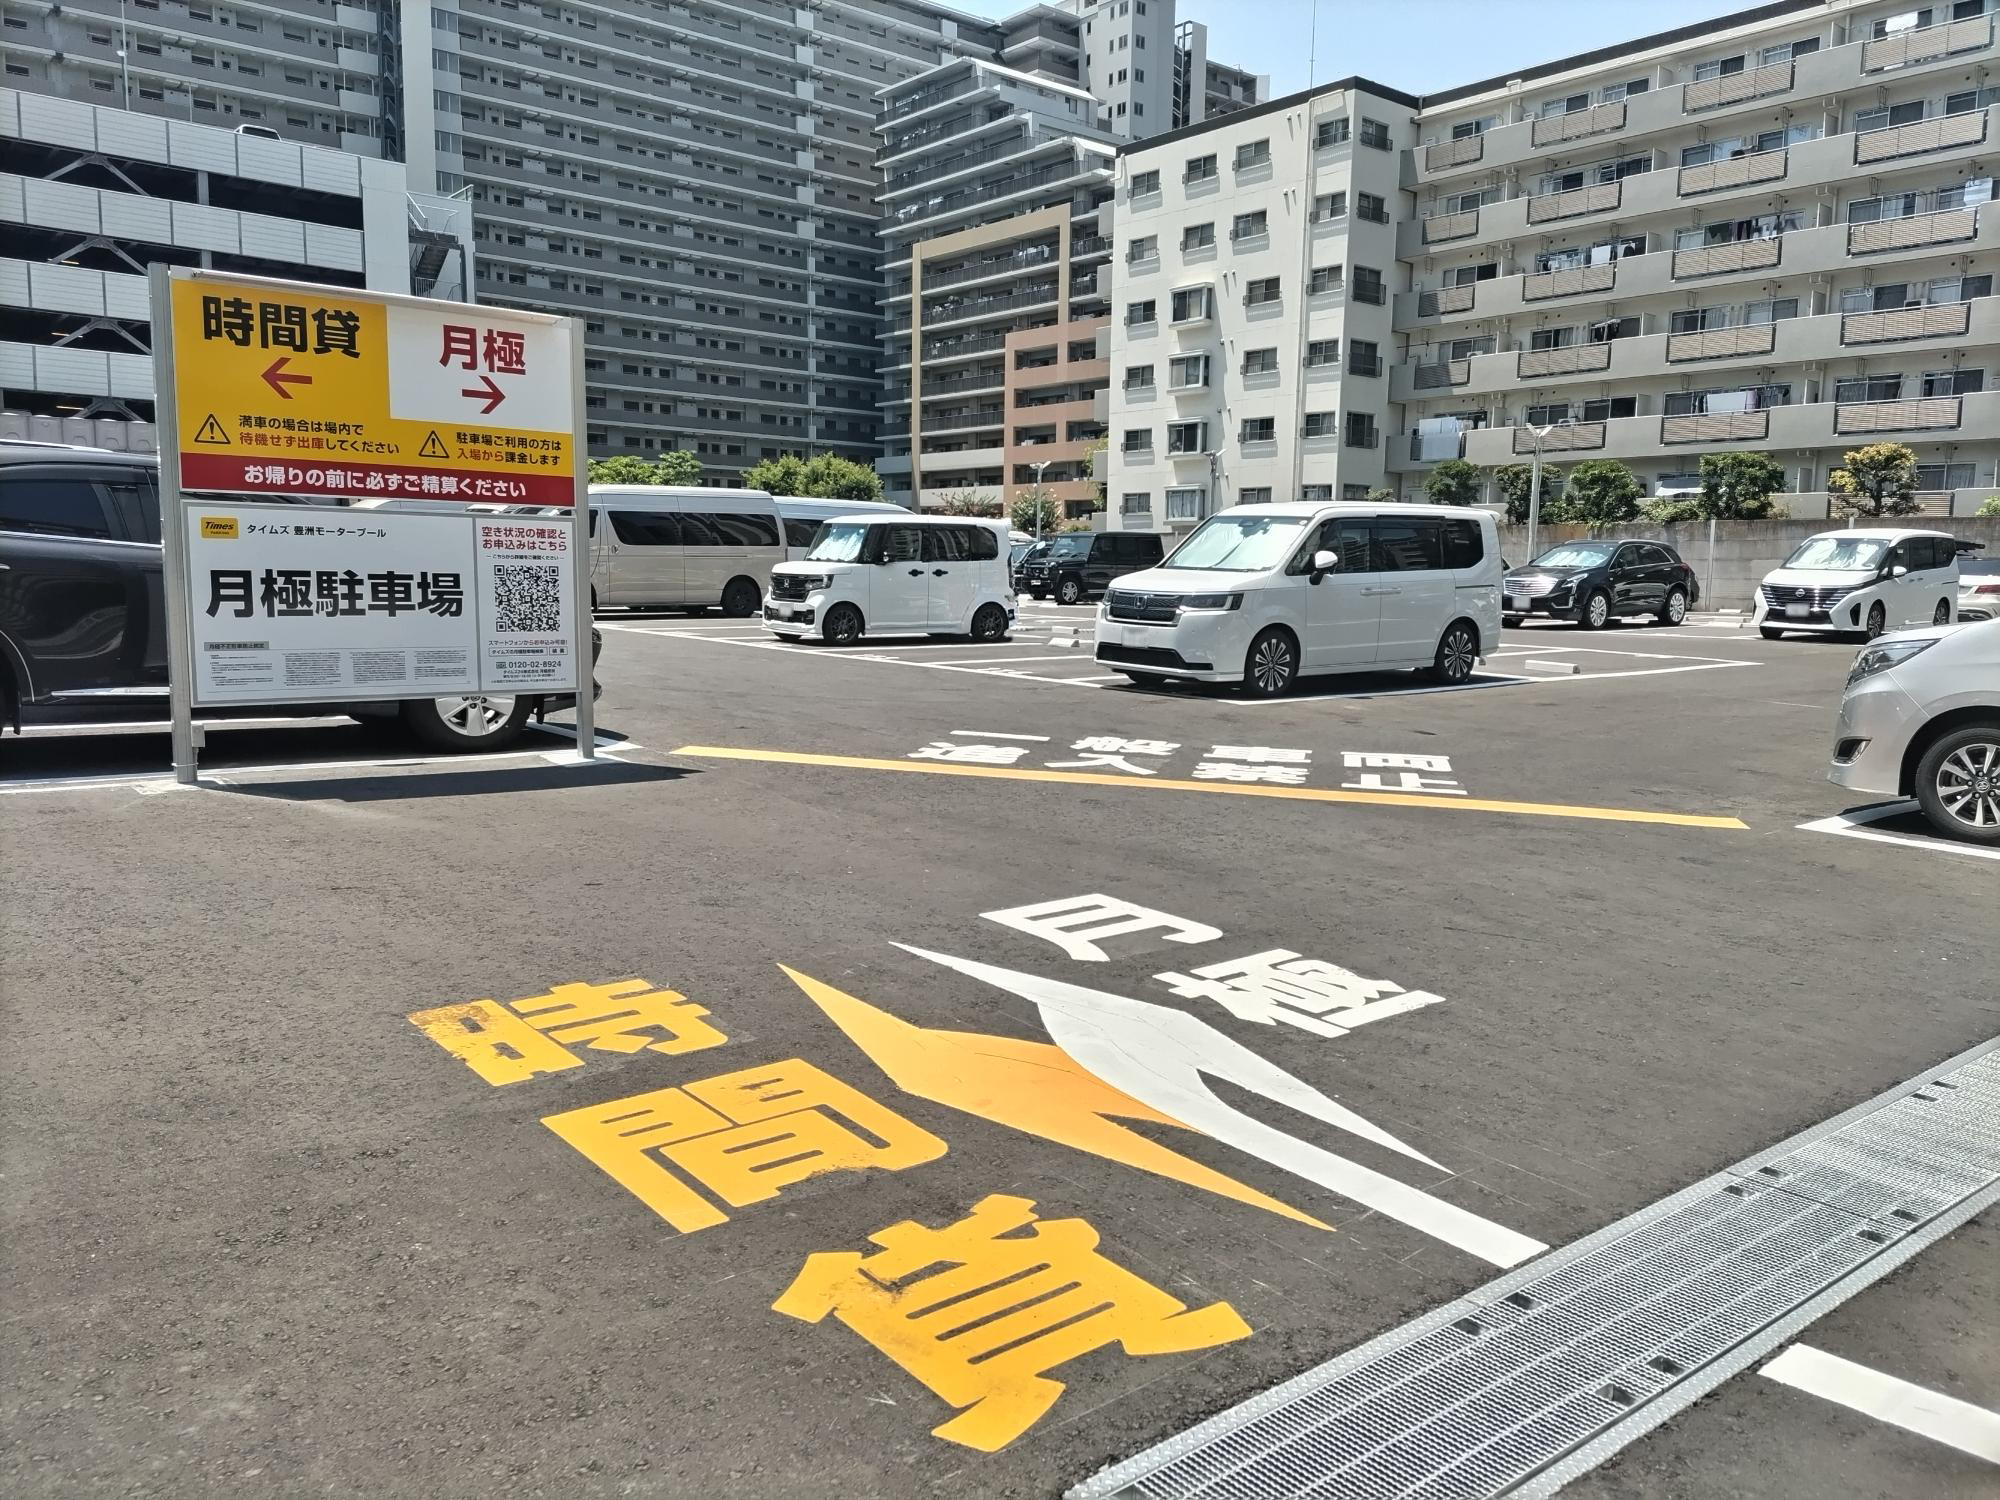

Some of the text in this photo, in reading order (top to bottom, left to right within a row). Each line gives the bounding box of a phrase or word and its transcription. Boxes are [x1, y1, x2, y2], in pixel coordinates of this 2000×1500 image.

[202, 295, 360, 358] 時間貸
[439, 324, 526, 375] 月極
[238, 414, 364, 433] 満車の場合は場内で
[239, 431, 399, 455] 待機せず出庫してください
[456, 431, 561, 451] 駐車場ご利用の方は
[456, 448, 560, 466] 入場から課金します
[244, 464, 526, 497] お帰りの前に必ずご精算ください
[205, 521, 235, 530] Times
[247, 524, 290, 535] タイムズ
[481, 526, 567, 540] 空き状況の確認と
[482, 539, 567, 551] お申込みはこちら
[205, 568, 464, 618] 月極駐車場
[950, 730, 1453, 772] 一般車両
[907, 742, 1468, 795] 進入禁止
[978, 893, 1447, 1039] 月極
[406, 978, 1253, 1453] 時間貸
